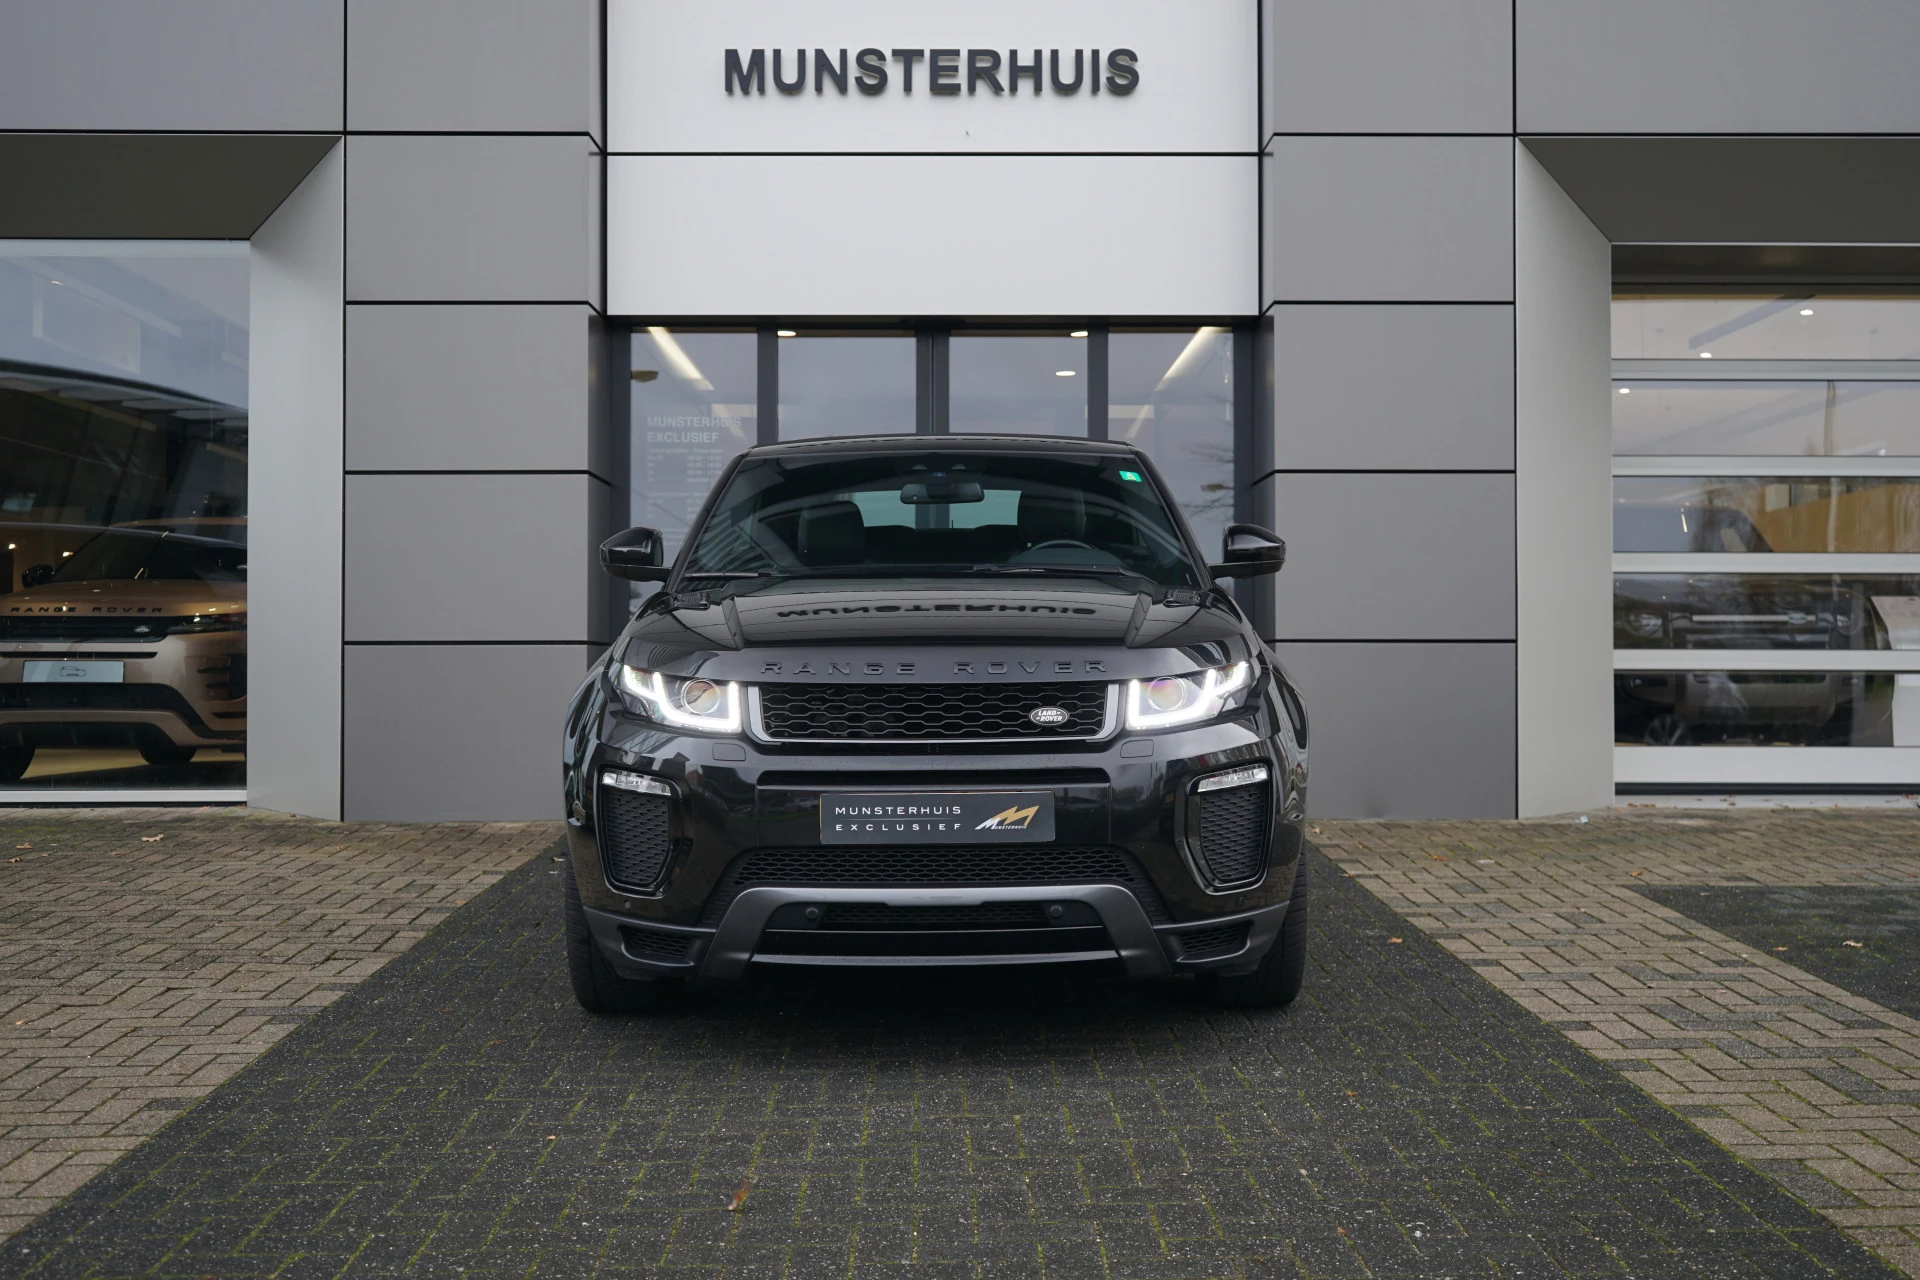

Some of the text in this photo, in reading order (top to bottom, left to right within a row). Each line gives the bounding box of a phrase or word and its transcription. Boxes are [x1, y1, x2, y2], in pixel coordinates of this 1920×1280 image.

[724, 48, 1140, 96] MUNSTERHUIS
[647, 432, 720, 443] EXCLUSIEF
[760, 659, 1107, 676] RANGE ROVER
[835, 806, 961, 815] MUNSTERHUIS
[835, 823, 961, 831] EXCLUSIEF
